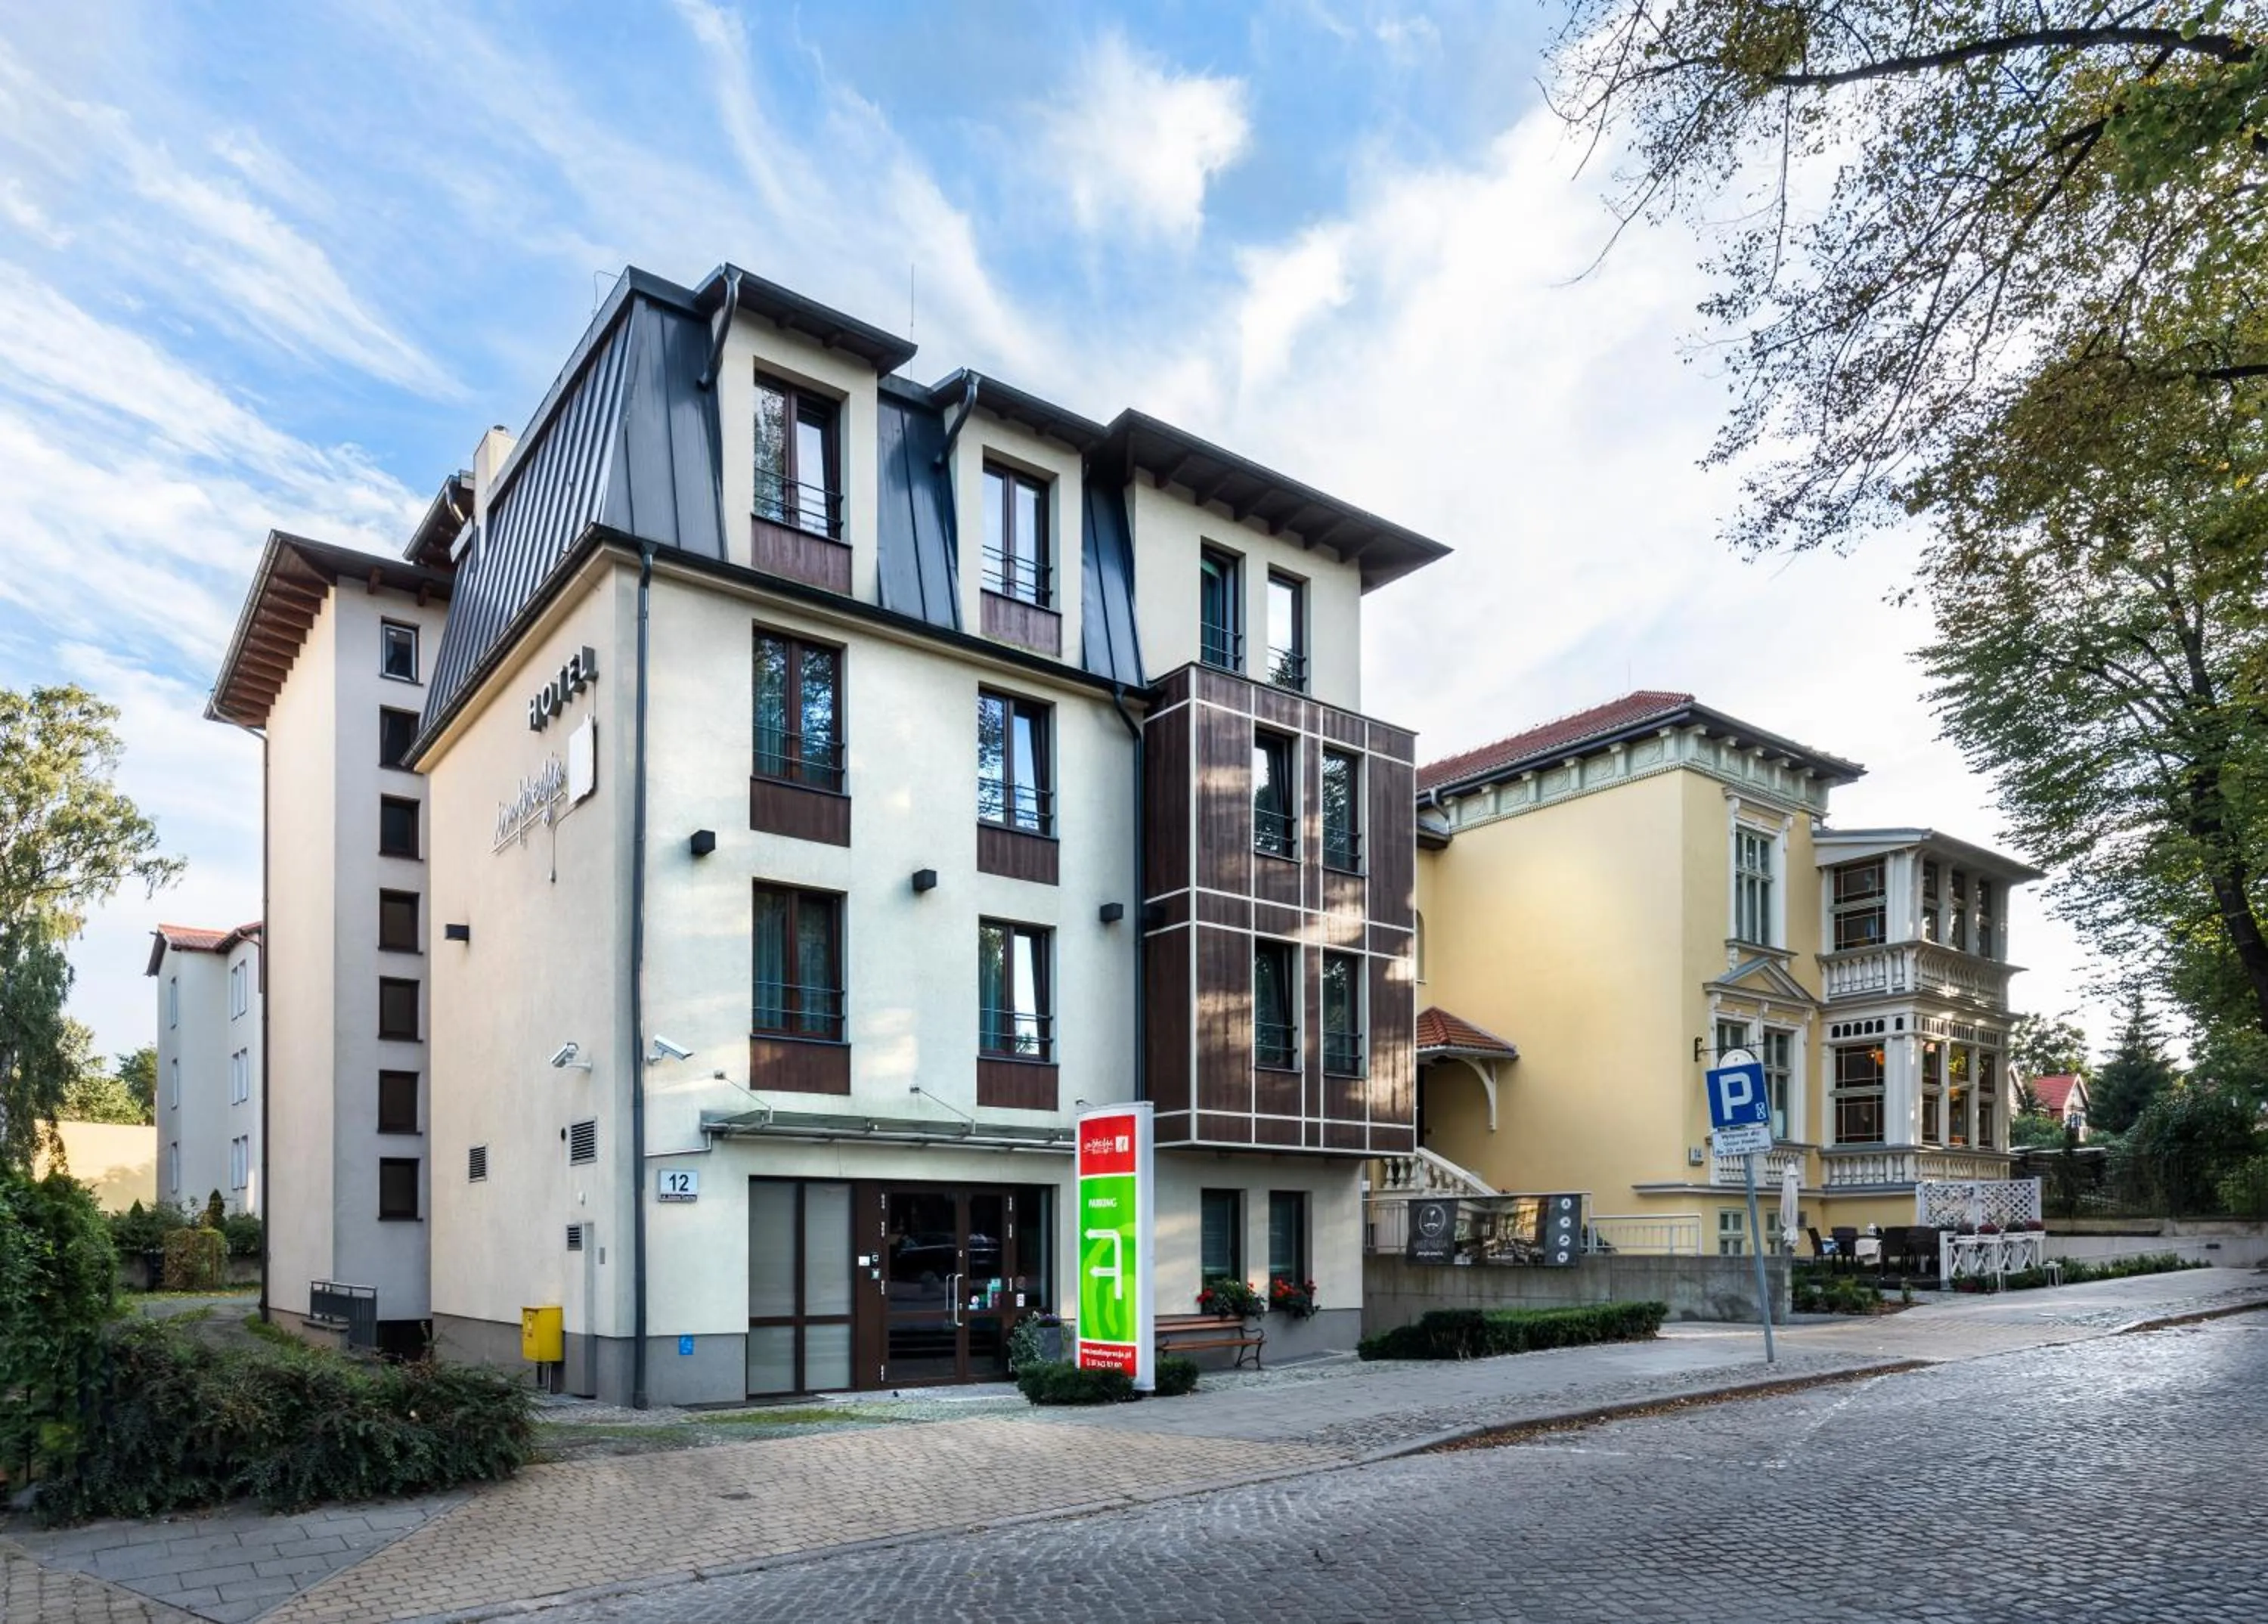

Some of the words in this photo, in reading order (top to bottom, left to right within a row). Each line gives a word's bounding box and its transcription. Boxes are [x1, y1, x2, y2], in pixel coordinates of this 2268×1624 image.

[528, 645, 593, 731] HOTEL
[1718, 1071, 1753, 1120] P
[669, 1173, 689, 1192] 12
